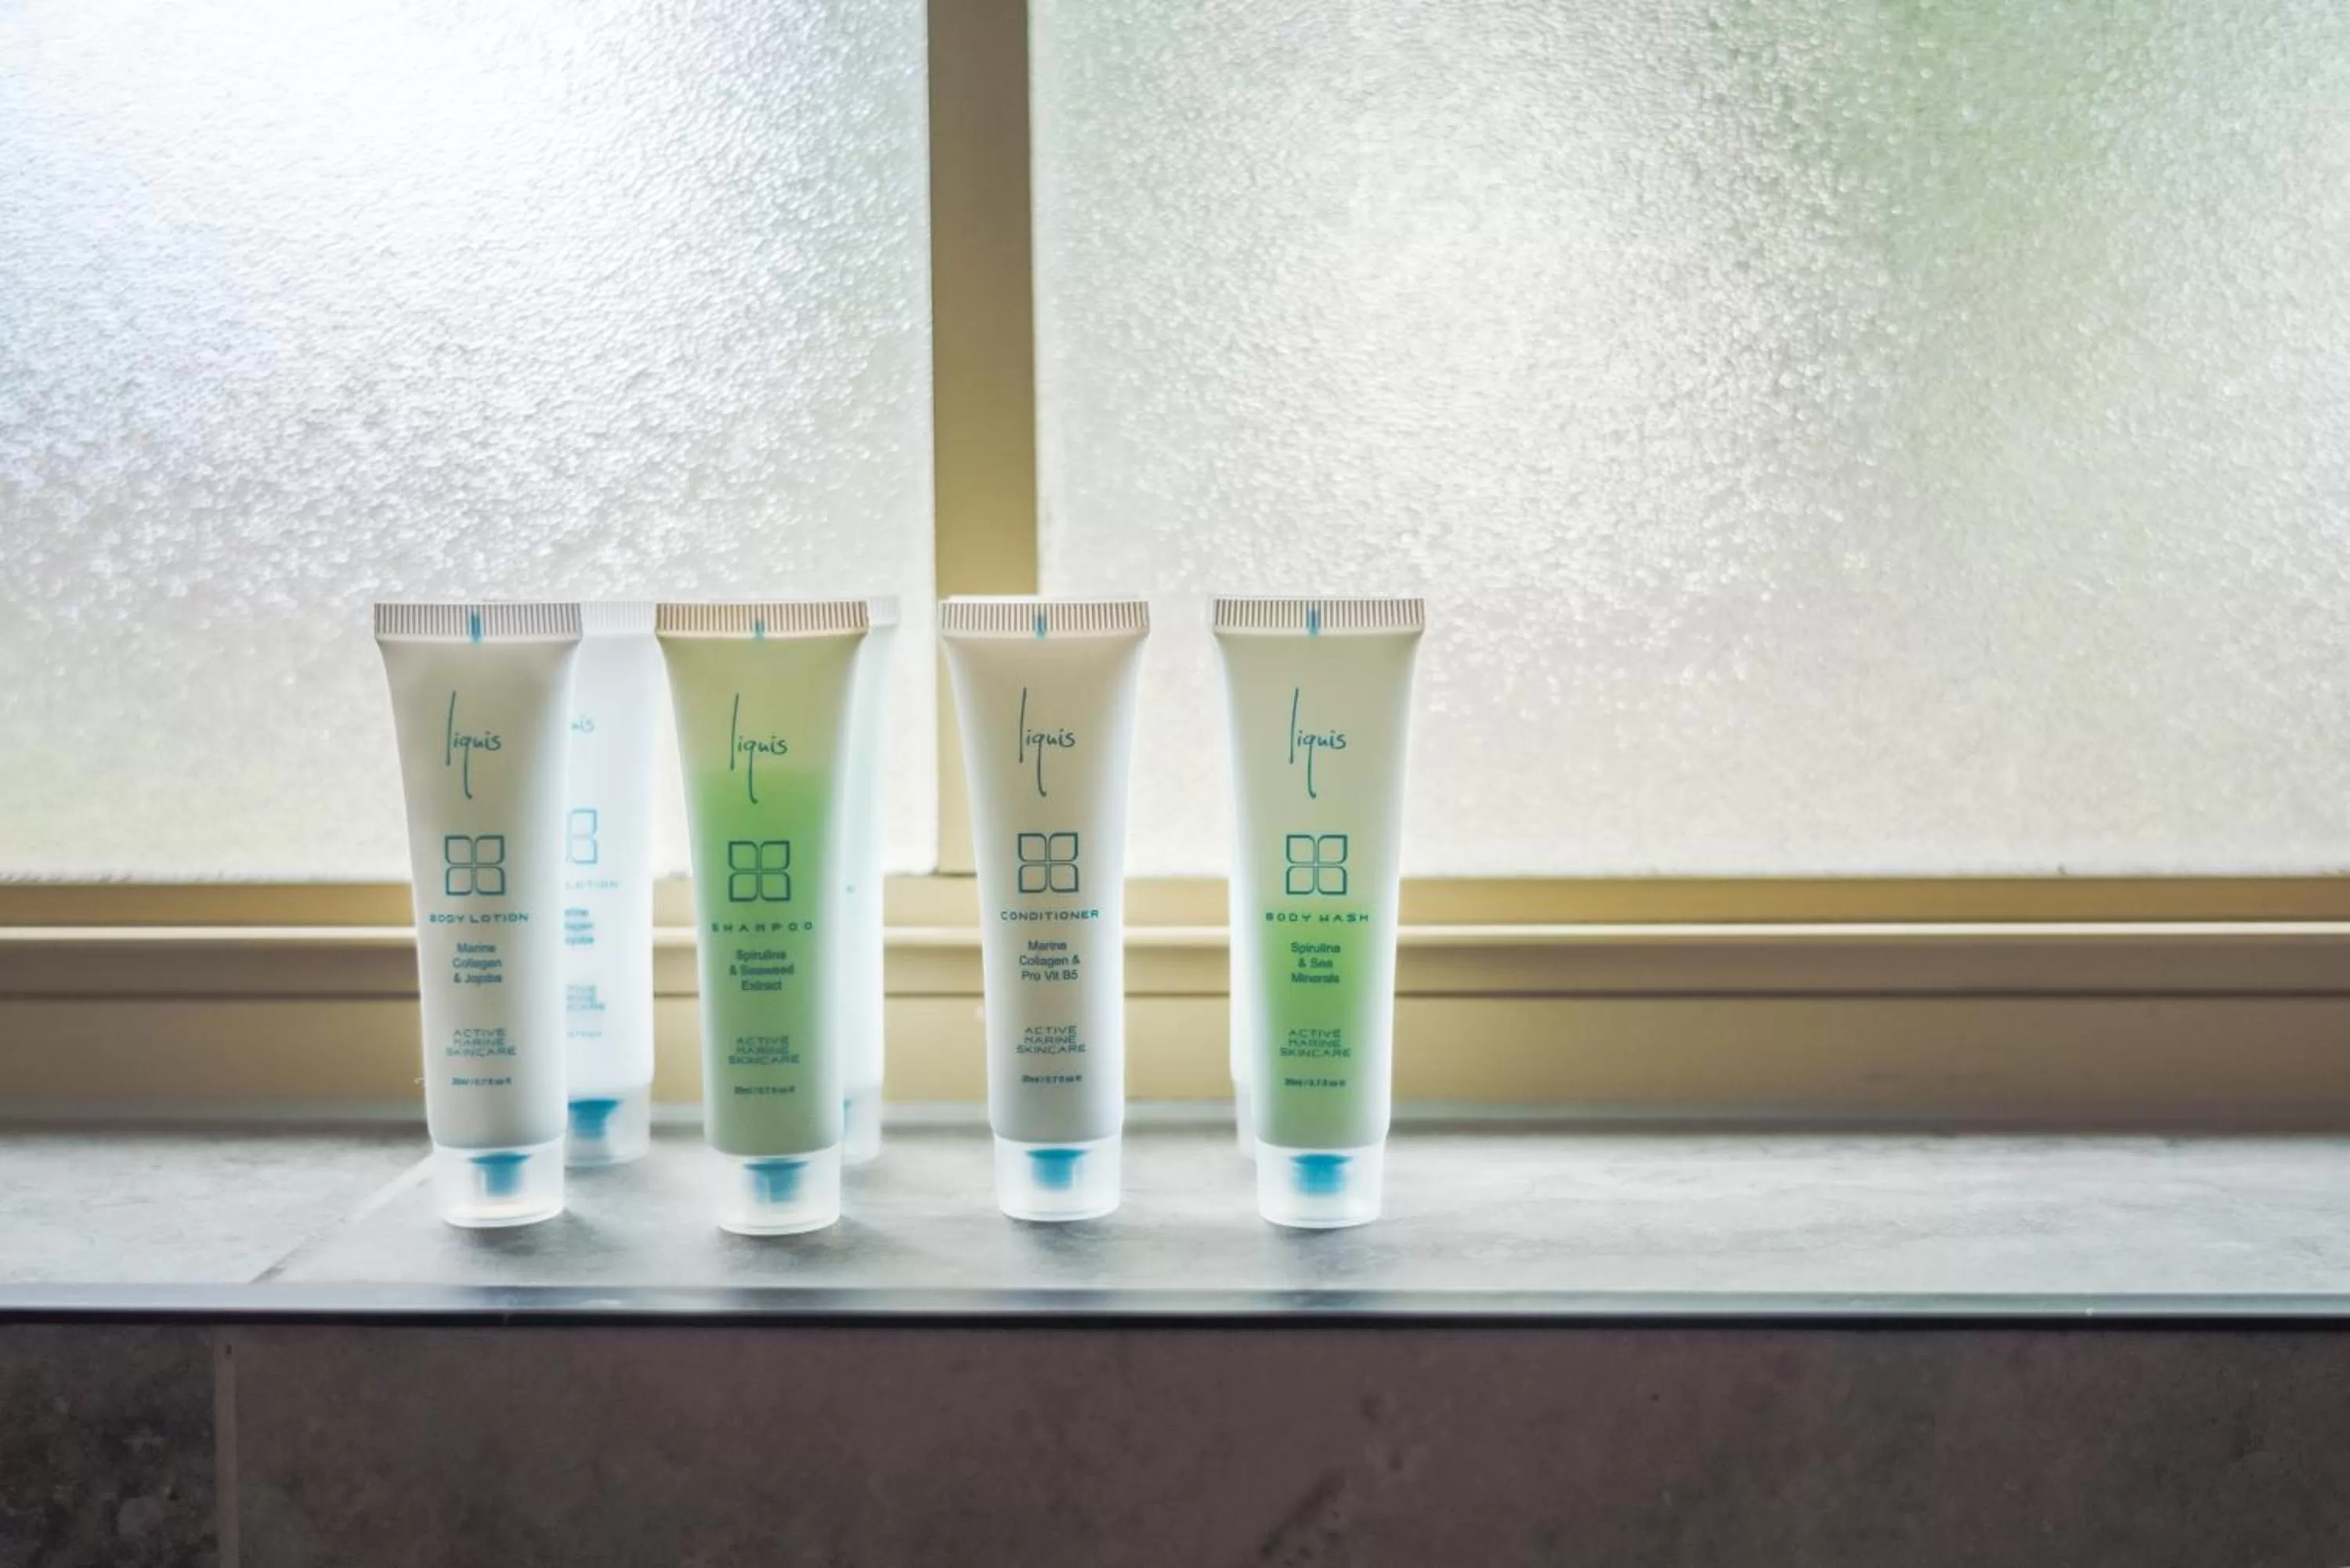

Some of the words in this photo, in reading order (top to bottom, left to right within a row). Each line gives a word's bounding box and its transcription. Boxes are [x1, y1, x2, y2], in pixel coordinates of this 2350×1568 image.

[446, 690, 502, 800] liquis
[1018, 686, 1076, 797] liquis
[1289, 687, 1347, 799] liquis
[728, 692, 789, 804] liquis
[429, 913, 465, 923] BODY
[470, 912, 530, 923] LOTION
[1000, 909, 1100, 921] CONDITIONER
[1265, 912, 1311, 923] BODY
[1319, 912, 1369, 923] WASH
[711, 921, 813, 932] SHAMPOO
[457, 942, 496, 953] Marine
[1028, 940, 1068, 951] Marine
[1291, 942, 1342, 954] Spirulina
[452, 957, 502, 970] Collagen
[1019, 955, 1069, 968] Collagen
[1072, 955, 1080, 966] &
[1297, 958, 1306, 968] &
[1310, 957, 1333, 969] Sea
[465, 973, 502, 985] Jojoba
[1021, 970, 1040, 981] Pro
[1063, 970, 1079, 981] B5
[1291, 972, 1340, 984] Minerals
[454, 1028, 506, 1038] ACTIVE
[1025, 1025, 1077, 1035] ACTIVE
[1289, 1028, 1342, 1038] ACTIVE
[1025, 1035, 1076, 1044] MARINE
[1016, 1044, 1087, 1054] SKINCARE
[1280, 1047, 1351, 1057] SKINCARE
